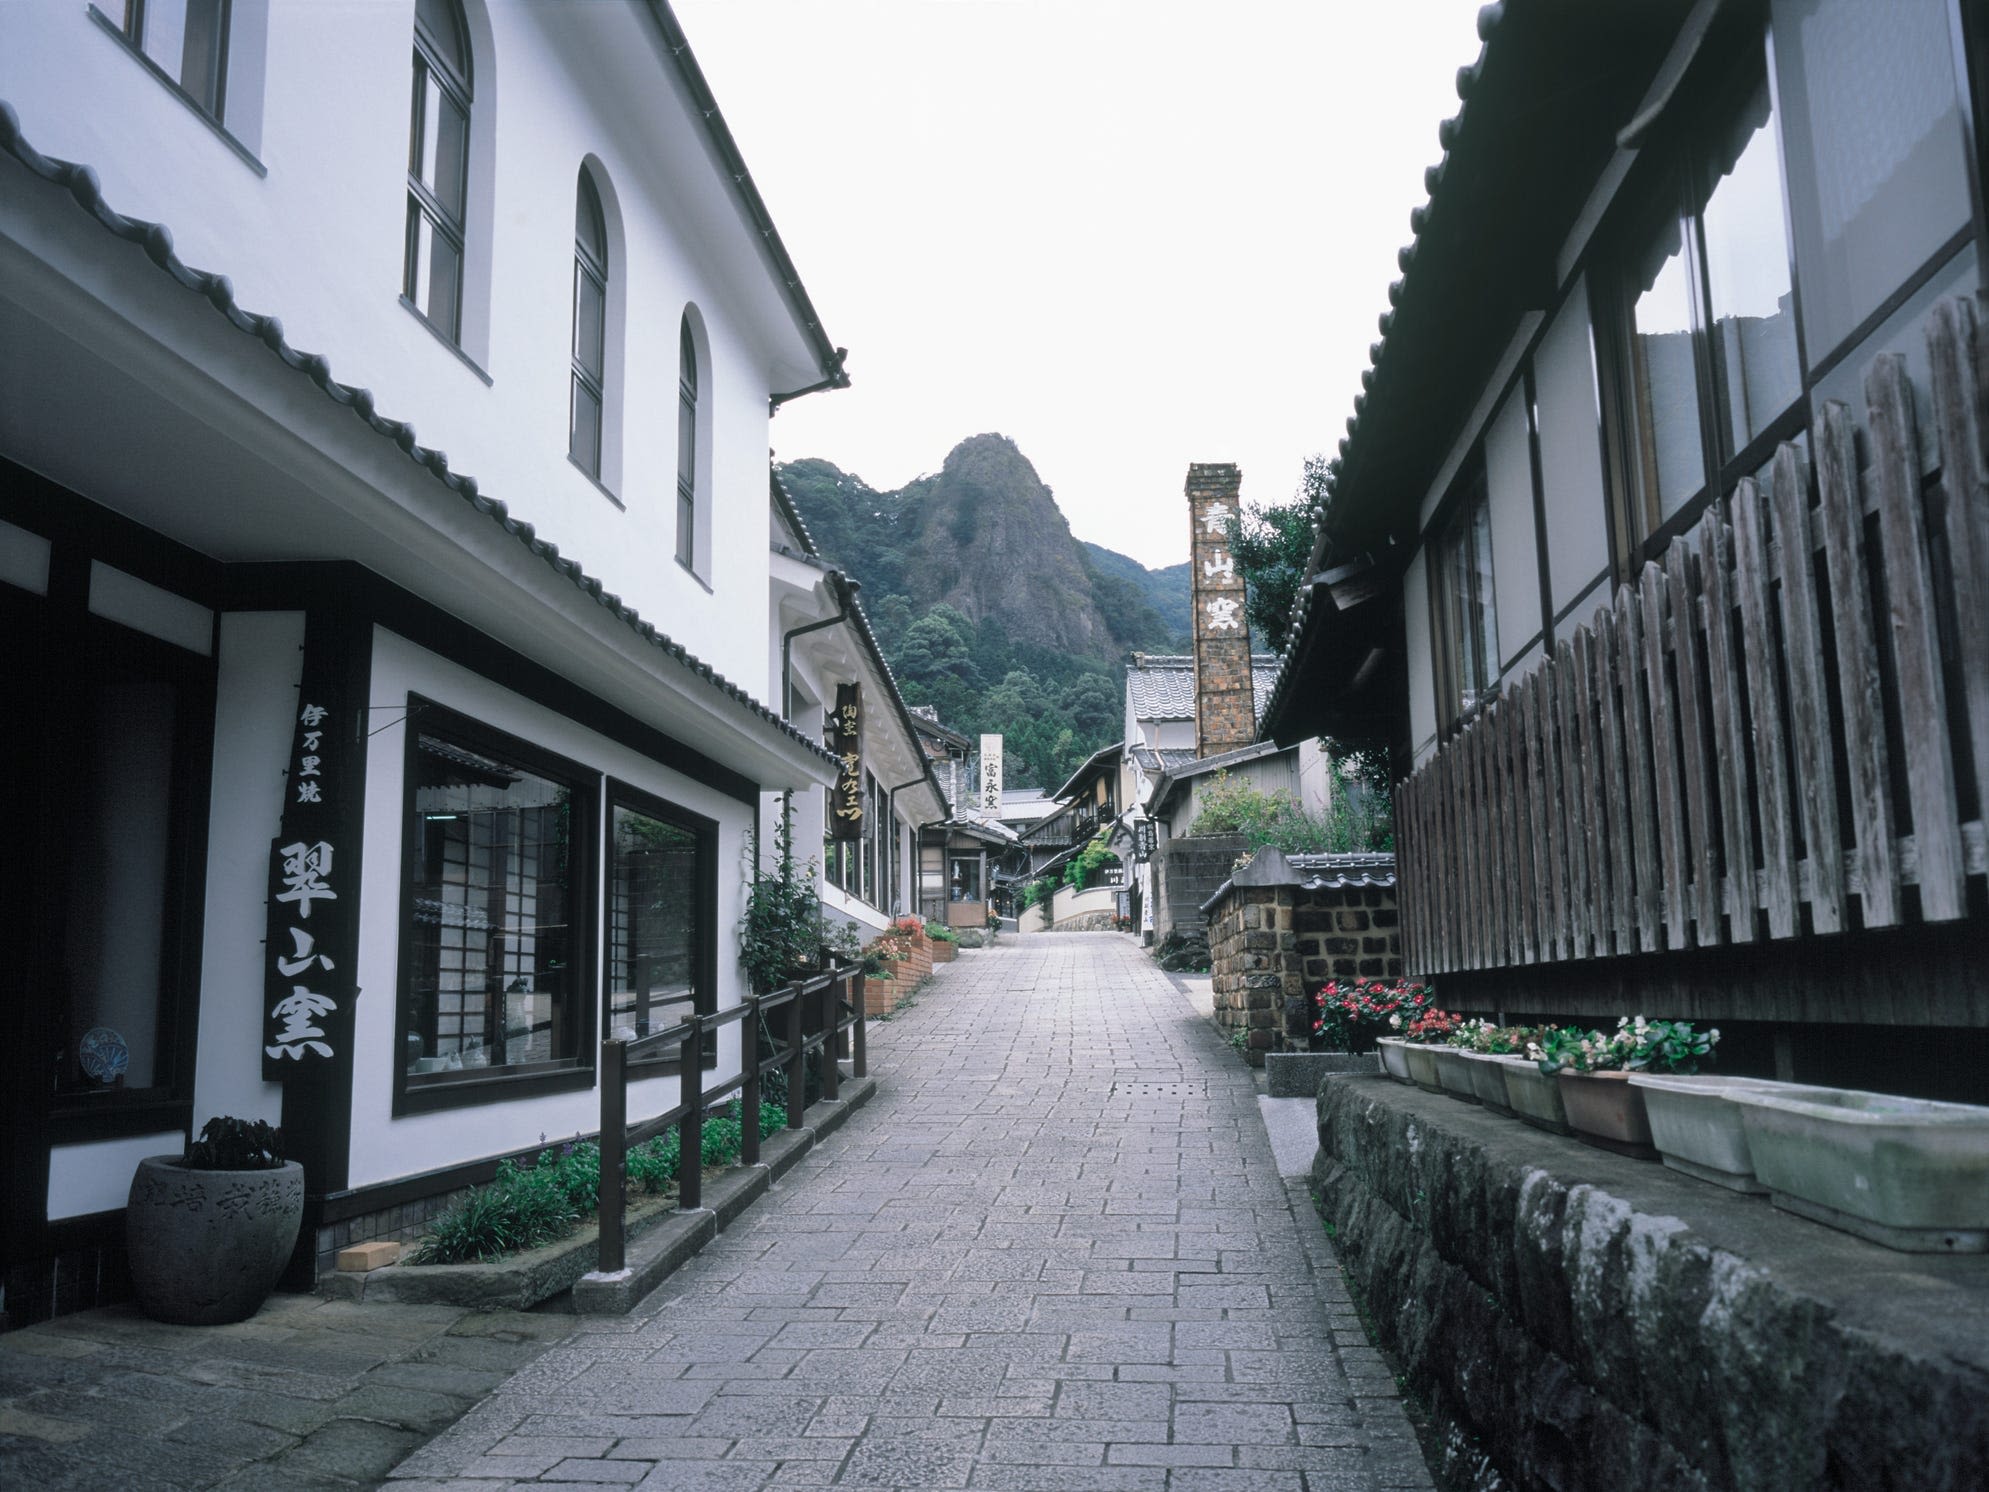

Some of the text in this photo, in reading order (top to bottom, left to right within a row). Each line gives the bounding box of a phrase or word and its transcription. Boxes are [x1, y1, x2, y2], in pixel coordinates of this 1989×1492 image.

[1200, 502, 1240, 630] 青山窯
[296, 703, 328, 803] 伊万里焼
[984, 763, 999, 810] 富永窯
[265, 840, 338, 1061] 翠山窯
